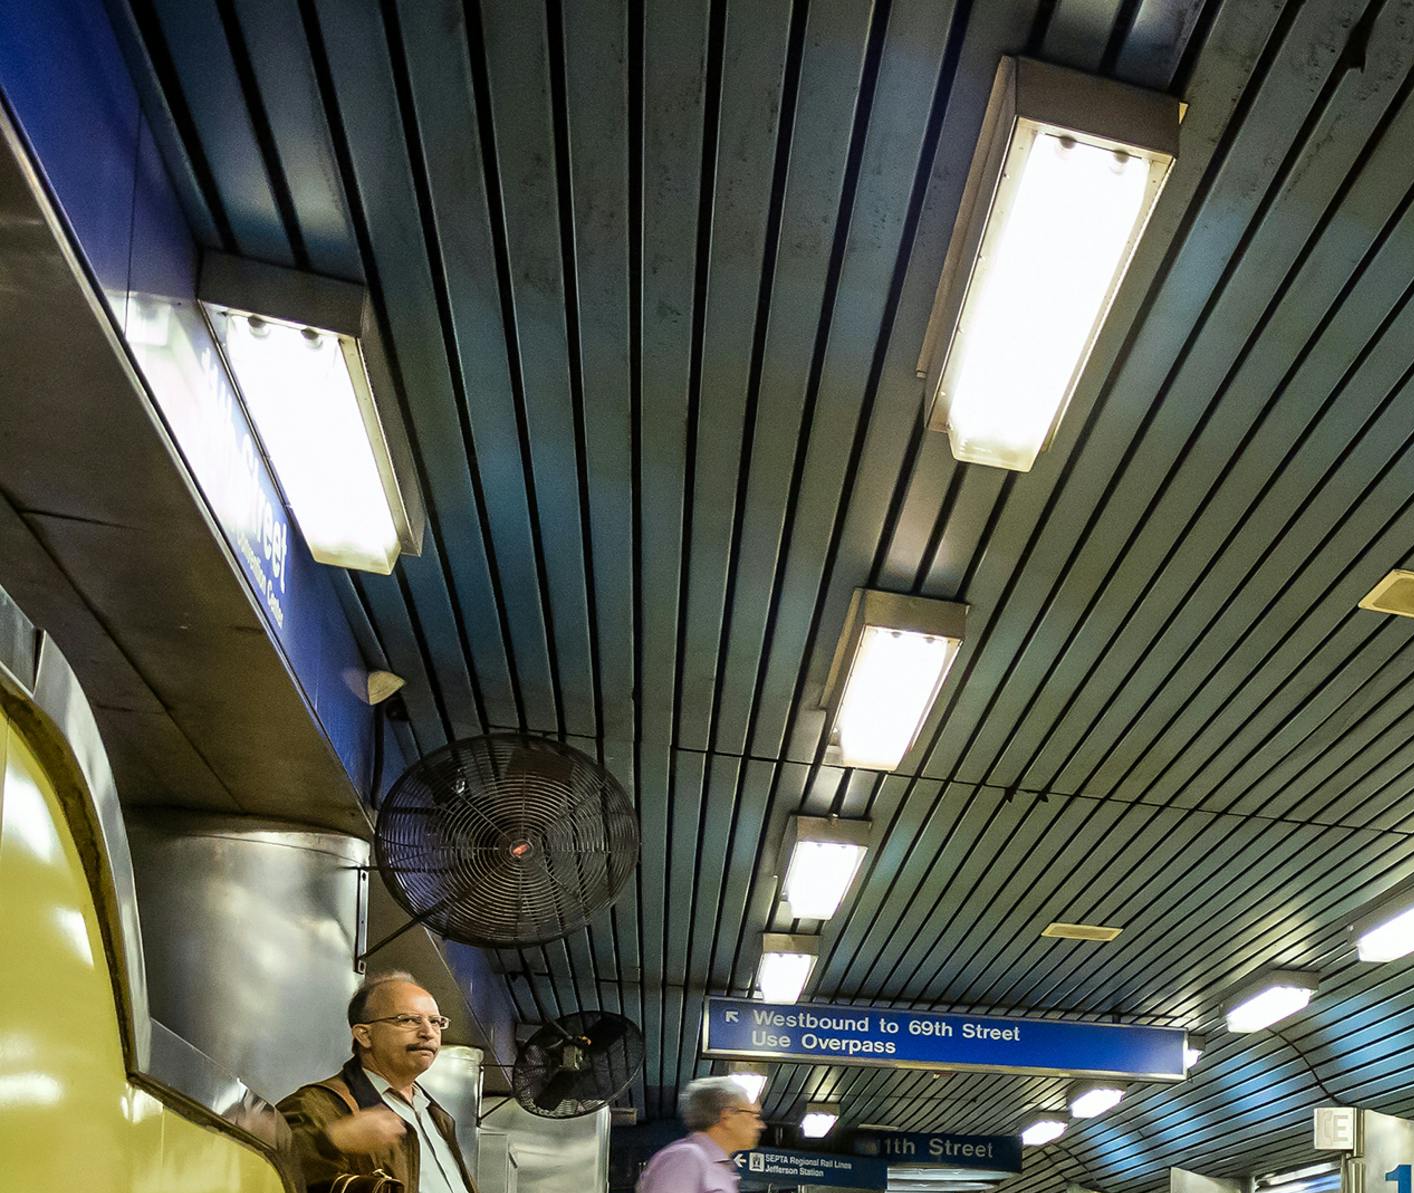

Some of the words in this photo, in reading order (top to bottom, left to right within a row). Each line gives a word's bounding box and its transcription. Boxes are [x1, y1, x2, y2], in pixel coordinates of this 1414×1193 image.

[753, 1010, 869, 1032] Westbound
[879, 1018, 900, 1034] to
[908, 1020, 953, 1037] 69th
[962, 1023, 1021, 1041] Street
[752, 1030, 792, 1048] Use
[801, 1033, 897, 1055] Overpass
[765, 1153, 788, 1163] SEPTA
[929, 1137, 993, 1159] Street
[765, 1164, 798, 1175] Jefferson
[799, 1167, 824, 1177] Station
